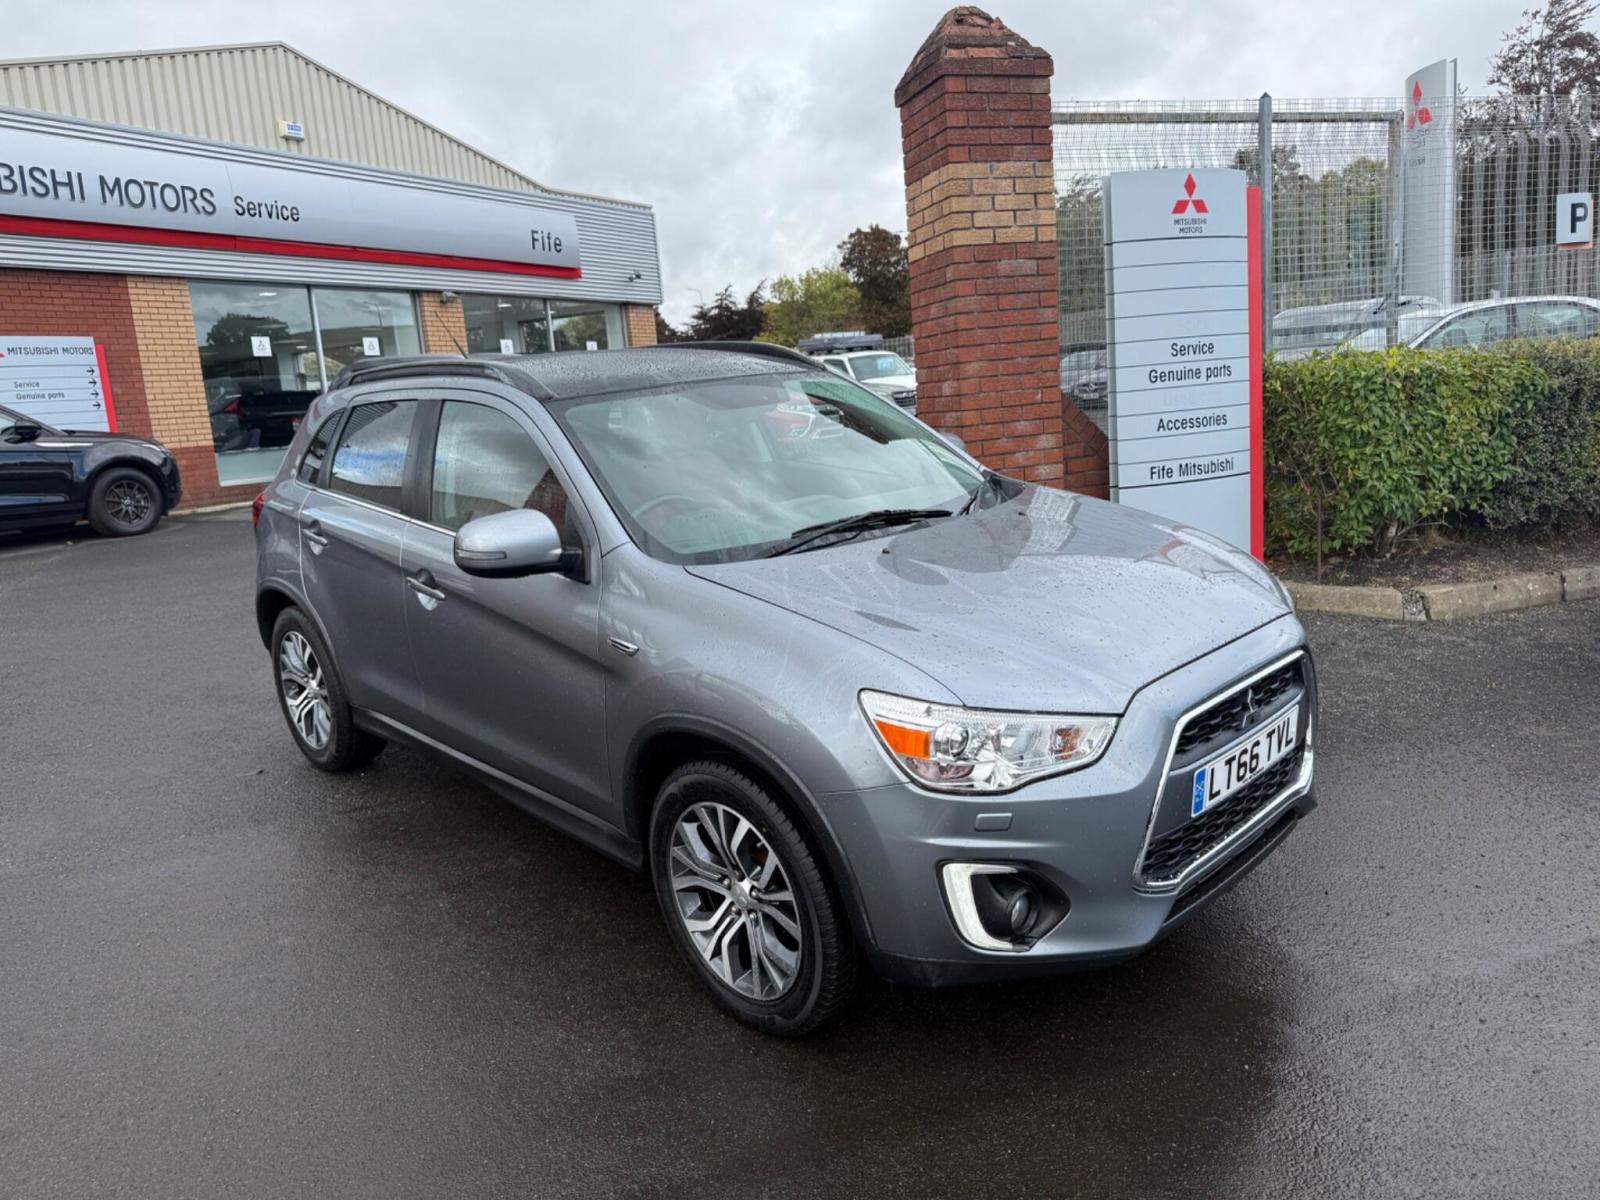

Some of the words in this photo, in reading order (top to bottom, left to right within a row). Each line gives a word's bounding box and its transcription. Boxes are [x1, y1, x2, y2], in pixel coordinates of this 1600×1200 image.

[99, 174, 217, 216] MOTORS
[234, 196, 300, 222] Service
[1571, 202, 1588, 233] P
[531, 229, 562, 253] Fife
[7, 347, 59, 355] MITSUBISHI
[62, 347, 94, 355] MOTORS
[1170, 341, 1215, 357] Service
[1148, 366, 1201, 383] Genuine
[1206, 364, 1232, 381] parts
[16, 392, 46, 400] Genuine
[48, 392, 65, 400] parts
[1156, 412, 1228, 432] Accessories
[1150, 465, 1173, 480] Fife
[1179, 457, 1234, 477] Mitsubishi
[1208, 740, 1261, 801] LT66
[1266, 717, 1293, 763] TVL
